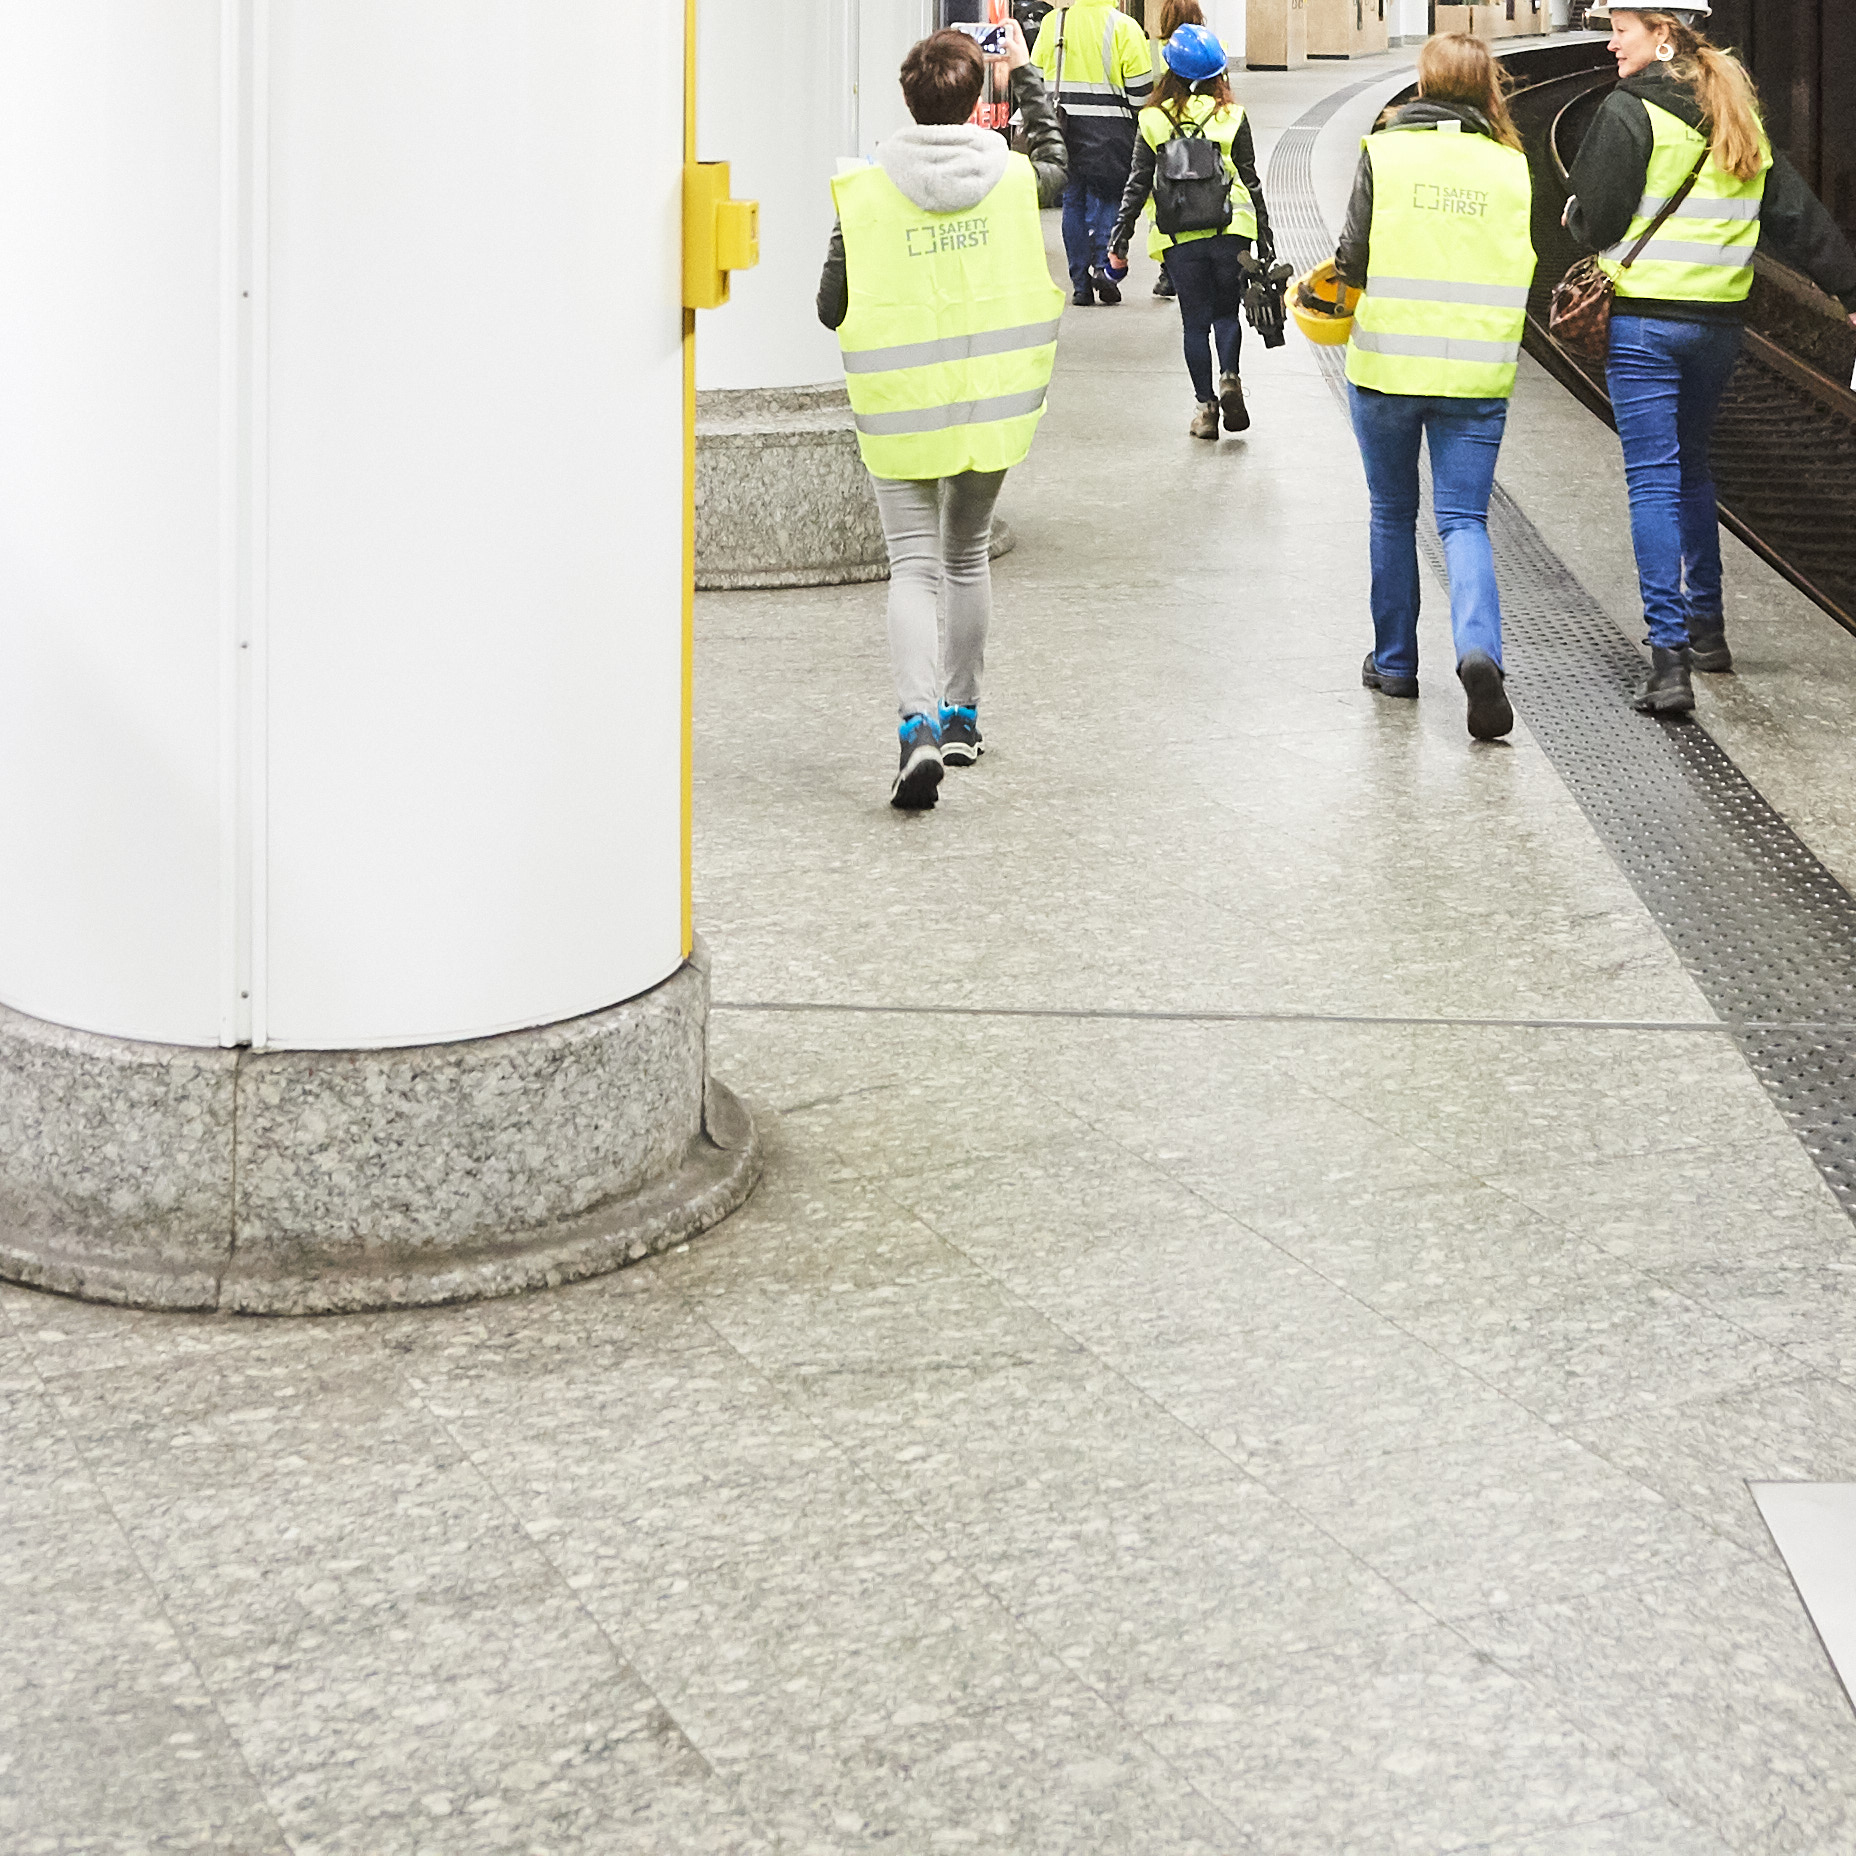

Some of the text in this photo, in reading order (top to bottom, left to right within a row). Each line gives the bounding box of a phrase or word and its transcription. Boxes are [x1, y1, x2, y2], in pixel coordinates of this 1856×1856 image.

[1443, 187, 1489, 202] SAFETY
[1443, 198, 1488, 217] FIRST
[939, 217, 988, 235] SAFETY
[940, 230, 989, 252] FIRST
